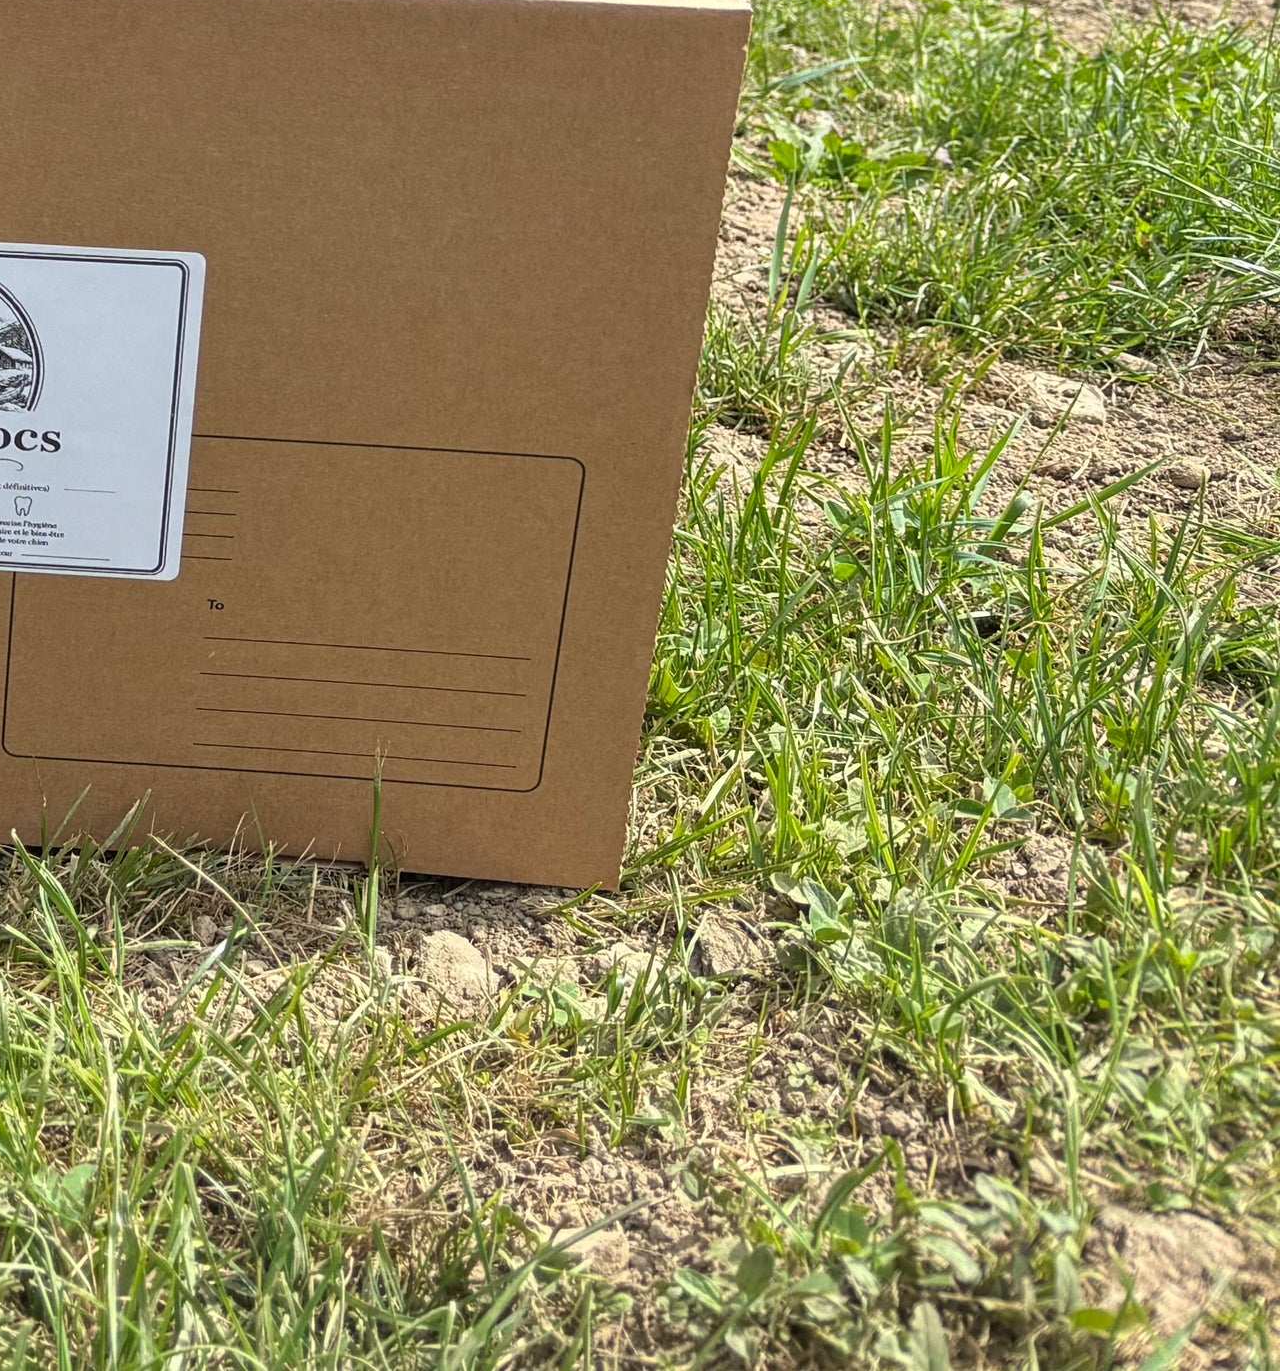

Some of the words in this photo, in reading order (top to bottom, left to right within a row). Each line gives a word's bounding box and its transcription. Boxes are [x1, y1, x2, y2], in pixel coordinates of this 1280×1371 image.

[2, 482, 50, 492] définitives)
[22, 528, 29, 536] le
[28, 538, 49, 546] chien
[207, 599, 225, 610] To
